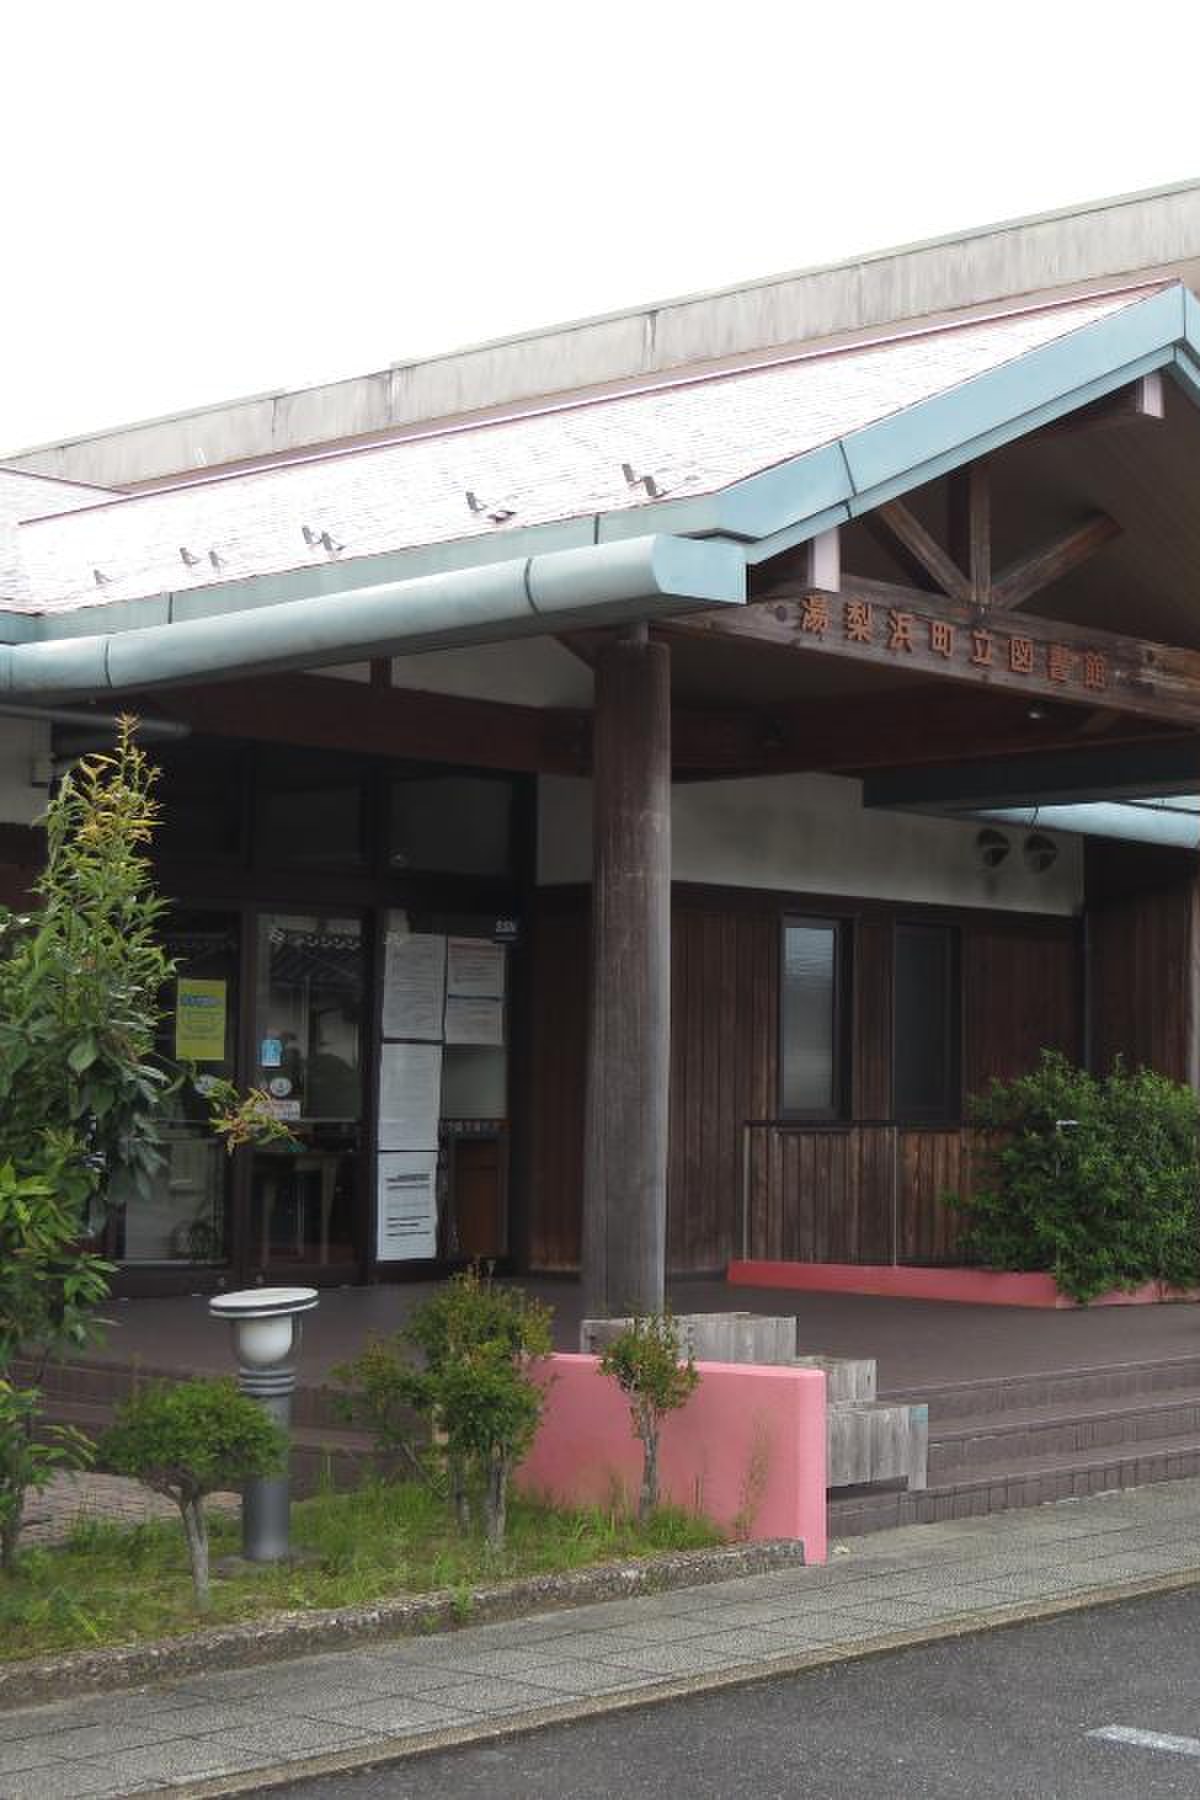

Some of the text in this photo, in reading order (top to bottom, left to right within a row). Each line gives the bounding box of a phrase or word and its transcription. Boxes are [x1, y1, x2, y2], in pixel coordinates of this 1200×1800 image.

[800, 592, 1107, 690] 湯梨浜町立図書館
